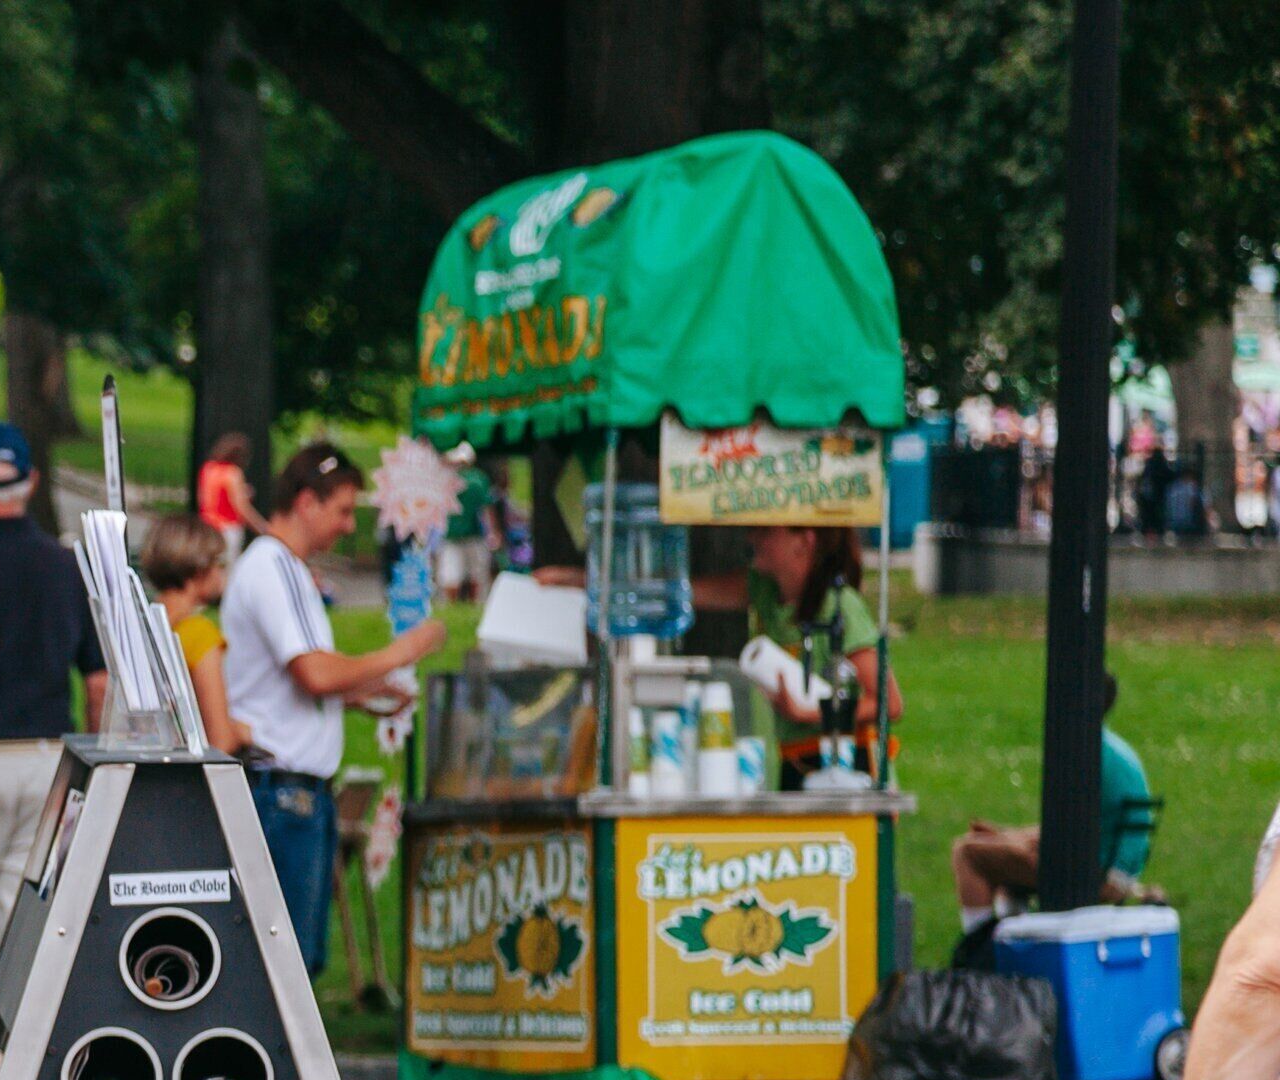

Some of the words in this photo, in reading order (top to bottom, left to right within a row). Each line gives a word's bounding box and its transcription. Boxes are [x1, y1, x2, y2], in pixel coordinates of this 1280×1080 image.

[711, 472, 871, 517] LEMONADE
[112, 882, 138, 897] The
[140, 881, 187, 897] Boston
[190, 879, 227, 895] Globe
[414, 838, 588, 949] LEMONADE
[642, 845, 854, 898] LEMONADE
[691, 991, 735, 1013] Ice
[743, 989, 812, 1013] Cold
